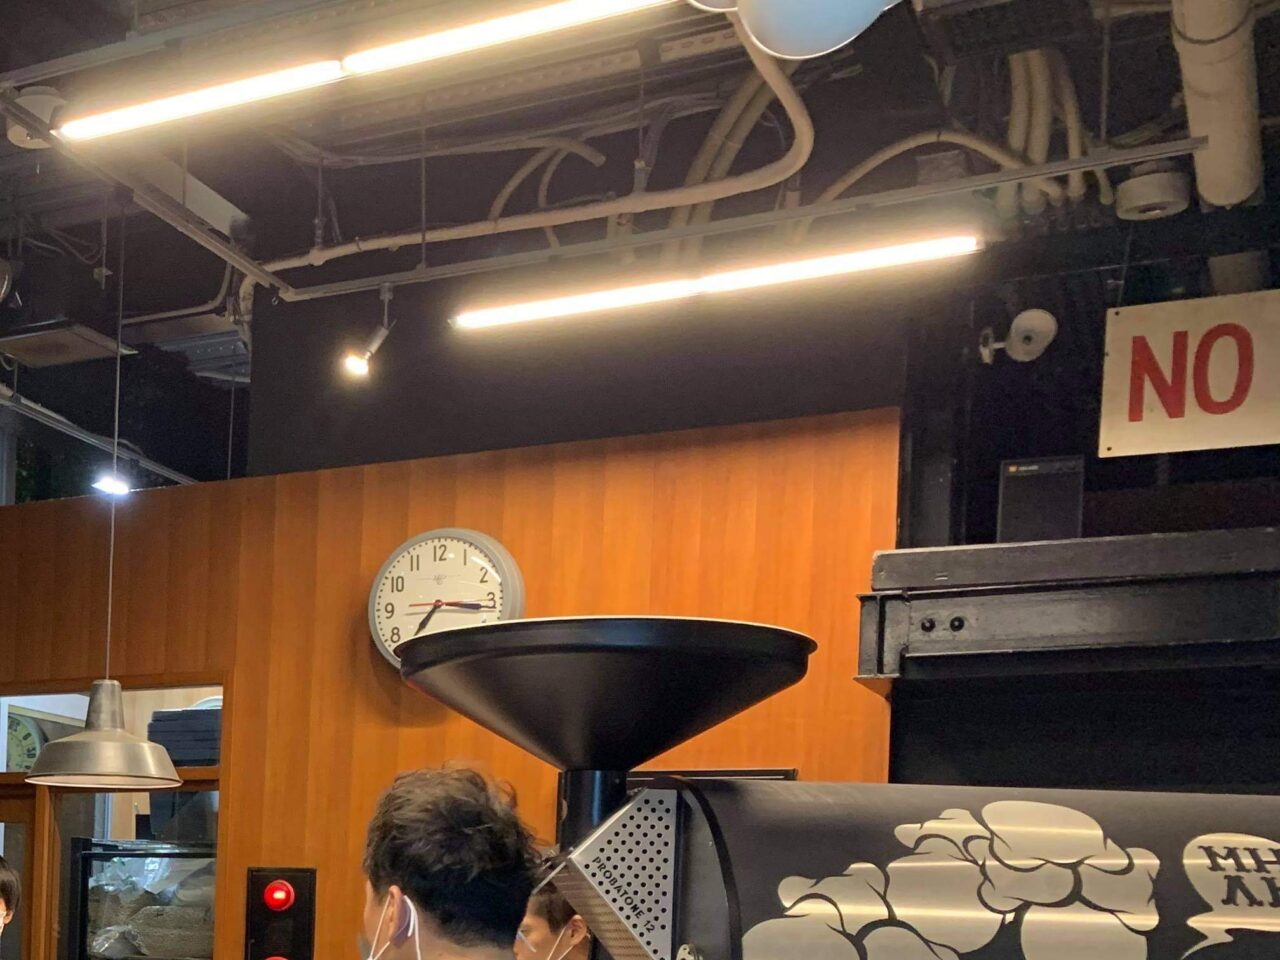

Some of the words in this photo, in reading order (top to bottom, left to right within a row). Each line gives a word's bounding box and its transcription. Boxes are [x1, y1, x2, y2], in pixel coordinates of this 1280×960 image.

[1128, 322, 1255, 423] NO
[433, 544, 448, 562] 12
[410, 554, 420, 572] 11
[479, 566, 489, 583] 2
[391, 576, 405, 593] 10
[486, 591, 497, 609] 3
[384, 602, 395, 619] 9
[390, 626, 401, 644] 8
[592, 856, 645, 919] PROBATONE
[643, 920, 656, 933] 12
